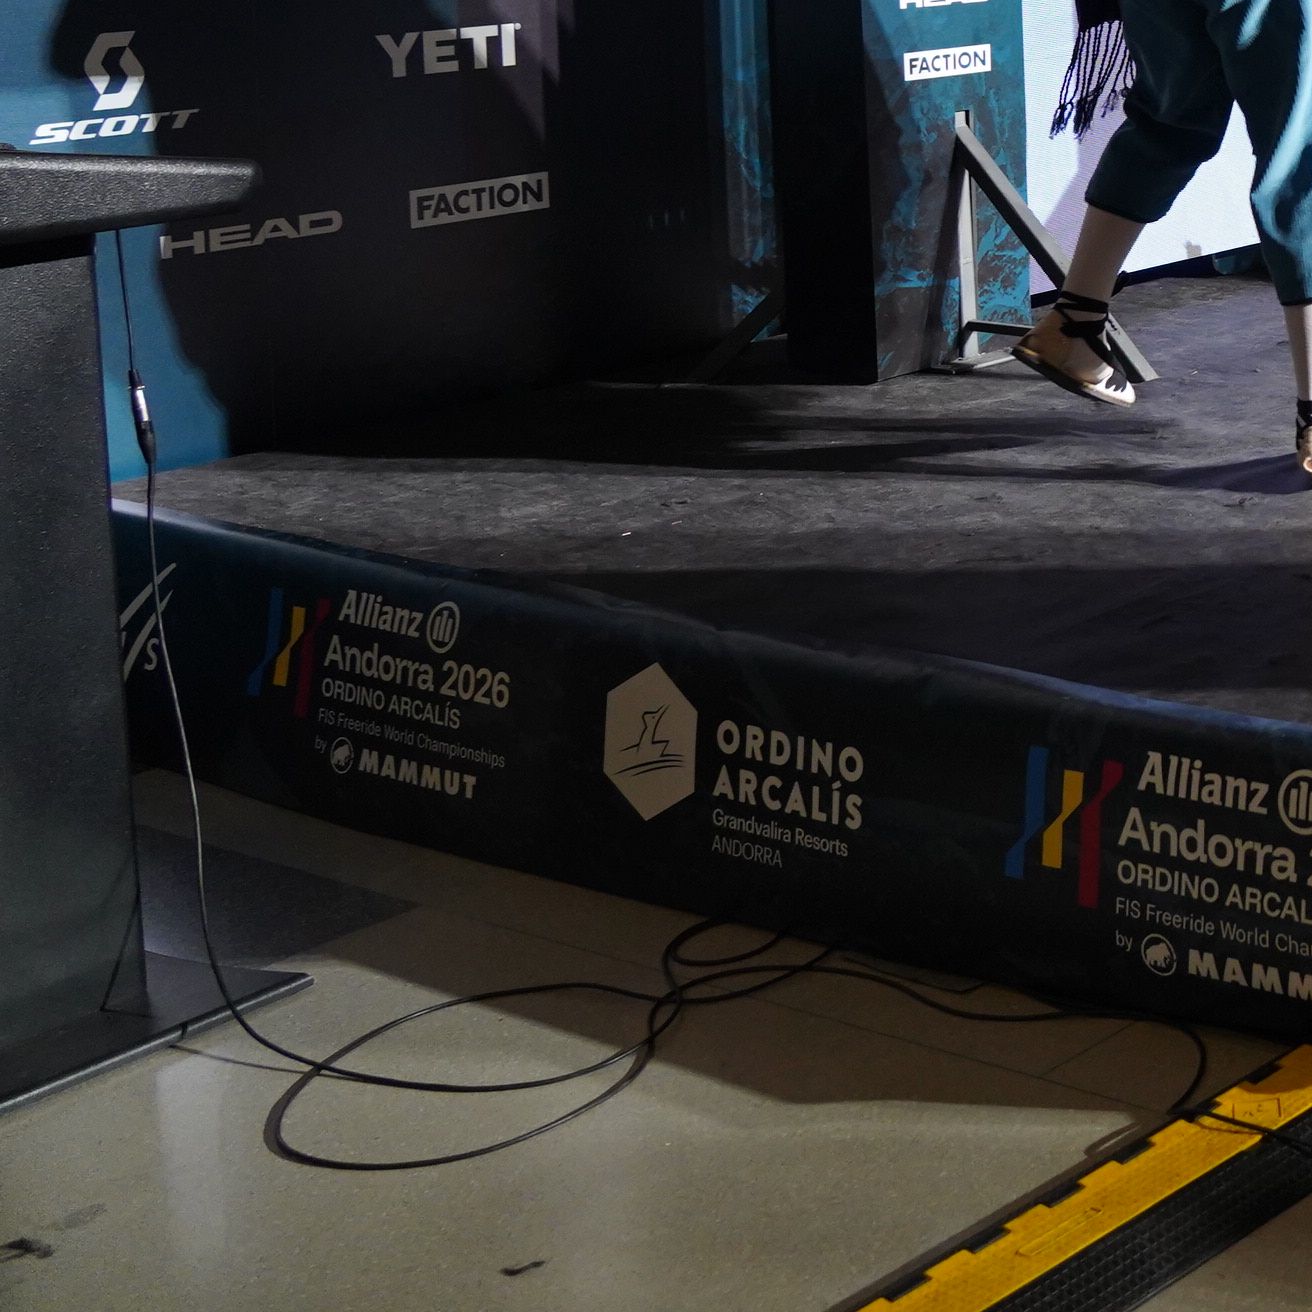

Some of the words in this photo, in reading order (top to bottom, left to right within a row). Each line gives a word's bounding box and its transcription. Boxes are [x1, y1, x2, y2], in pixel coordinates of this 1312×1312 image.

[375, 22, 518, 78] YETI
[909, 50, 987, 76] FACTION
[28, 108, 201, 145] SCOTT
[416, 178, 546, 222] FACTION
[159, 209, 343, 260] HEAD
[338, 588, 425, 638] Allianz
[323, 633, 435, 693] Andorra
[439, 660, 512, 708] 2026
[321, 677, 385, 710] ORDINO
[388, 694, 461, 729] ARCALÍS
[318, 708, 335, 725] FIS
[337, 712, 382, 737] Freeride
[384, 724, 415, 745] World
[417, 733, 506, 769] Championships
[716, 719, 864, 783] ORDINO
[314, 735, 328, 753] by
[358, 748, 478, 799] MAMMUT
[1136, 750, 1270, 815] Allianz
[711, 763, 864, 830] ARCALÍS
[711, 835, 783, 869] ANDORRA
[712, 808, 792, 843] Grandvalira
[795, 827, 849, 857] Resorts
[1117, 806, 1298, 883] Andorra
[1116, 859, 1220, 903] ORDINO
[1115, 896, 1141, 920] FIS
[1145, 903, 1216, 936] Freeride
[1219, 919, 1270, 949] World
[1115, 930, 1134, 952] by
